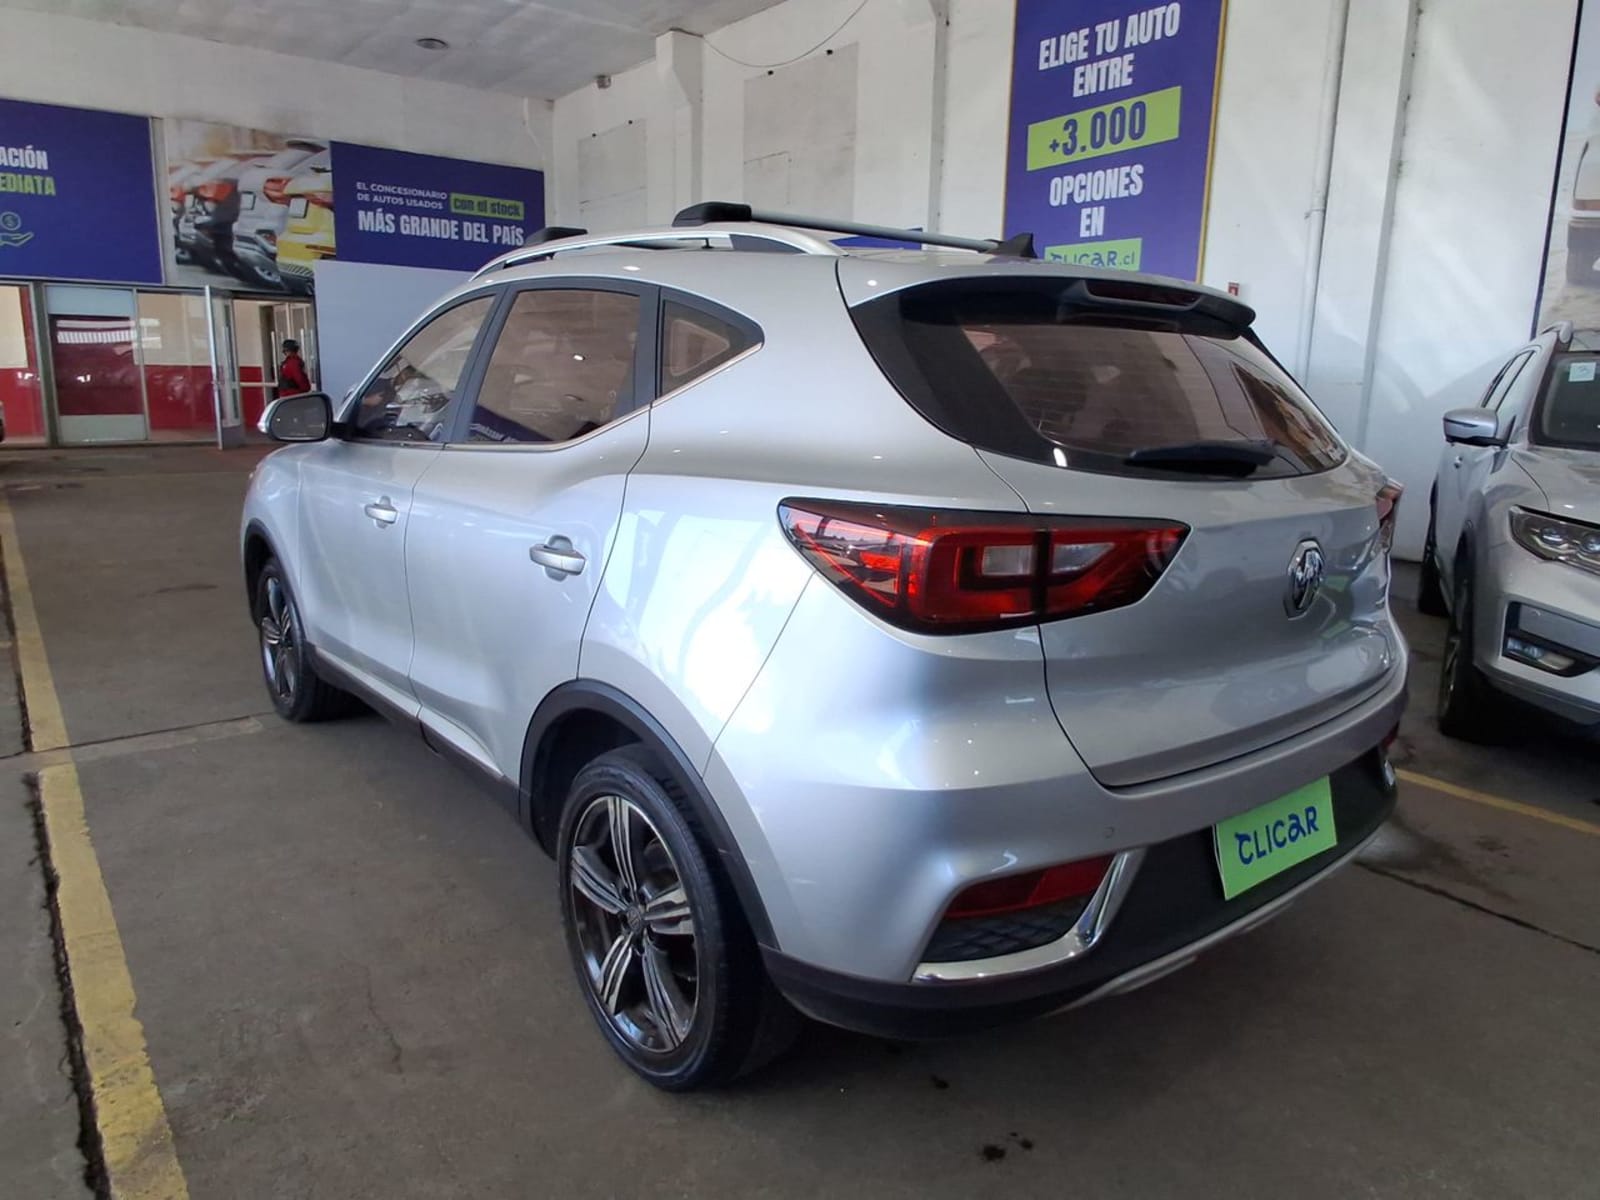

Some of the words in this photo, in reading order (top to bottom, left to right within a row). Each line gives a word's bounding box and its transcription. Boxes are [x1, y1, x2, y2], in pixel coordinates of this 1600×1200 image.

[1038, 28, 1089, 71] ELIGE
[1095, 19, 1120, 56] TU
[1124, 2, 1181, 48] AUTO
[1073, 53, 1135, 98] ENTRE
[1049, 101, 1147, 156] +3.000
[0, 144, 48, 170] ACIÓN
[356, 182, 368, 191] EL
[370, 183, 448, 200] CONCESIONARIO
[357, 193, 370, 201] DE
[372, 195, 404, 206] AUTOS
[406, 199, 444, 210] USADOS
[1049, 164, 1144, 207] OPCIONES
[453, 198, 475, 210] con
[490, 201, 521, 217] stock
[1079, 206, 1105, 238] EN
[358, 208, 395, 234] MÁS
[400, 214, 460, 240] GRANDE
[463, 221, 489, 243] DEL
[492, 224, 524, 246] PAÍS
